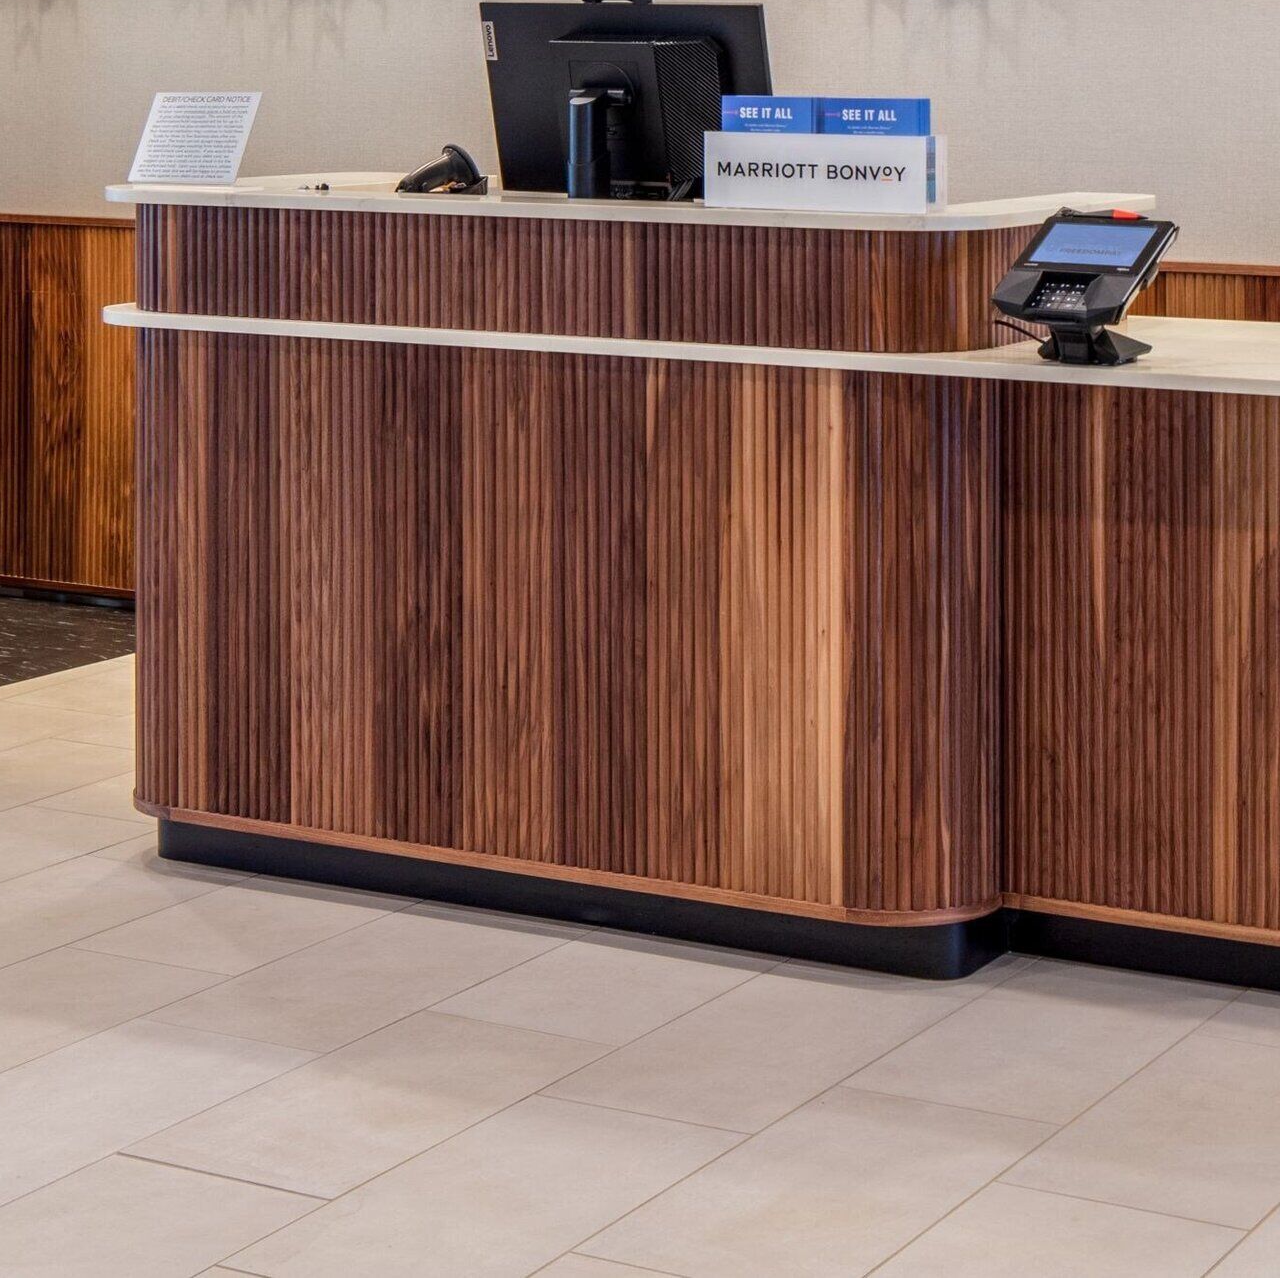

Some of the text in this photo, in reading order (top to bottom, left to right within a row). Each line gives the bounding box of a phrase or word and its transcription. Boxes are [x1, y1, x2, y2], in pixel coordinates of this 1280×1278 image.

[485, 24, 494, 58] Lenovo
[207, 95, 225, 103] CARD
[226, 95, 251, 103] NOTICE
[739, 106, 793, 120] SEE IT ALL
[842, 108, 897, 122] SEE IT ALL
[717, 161, 819, 179] MARRIOTT
